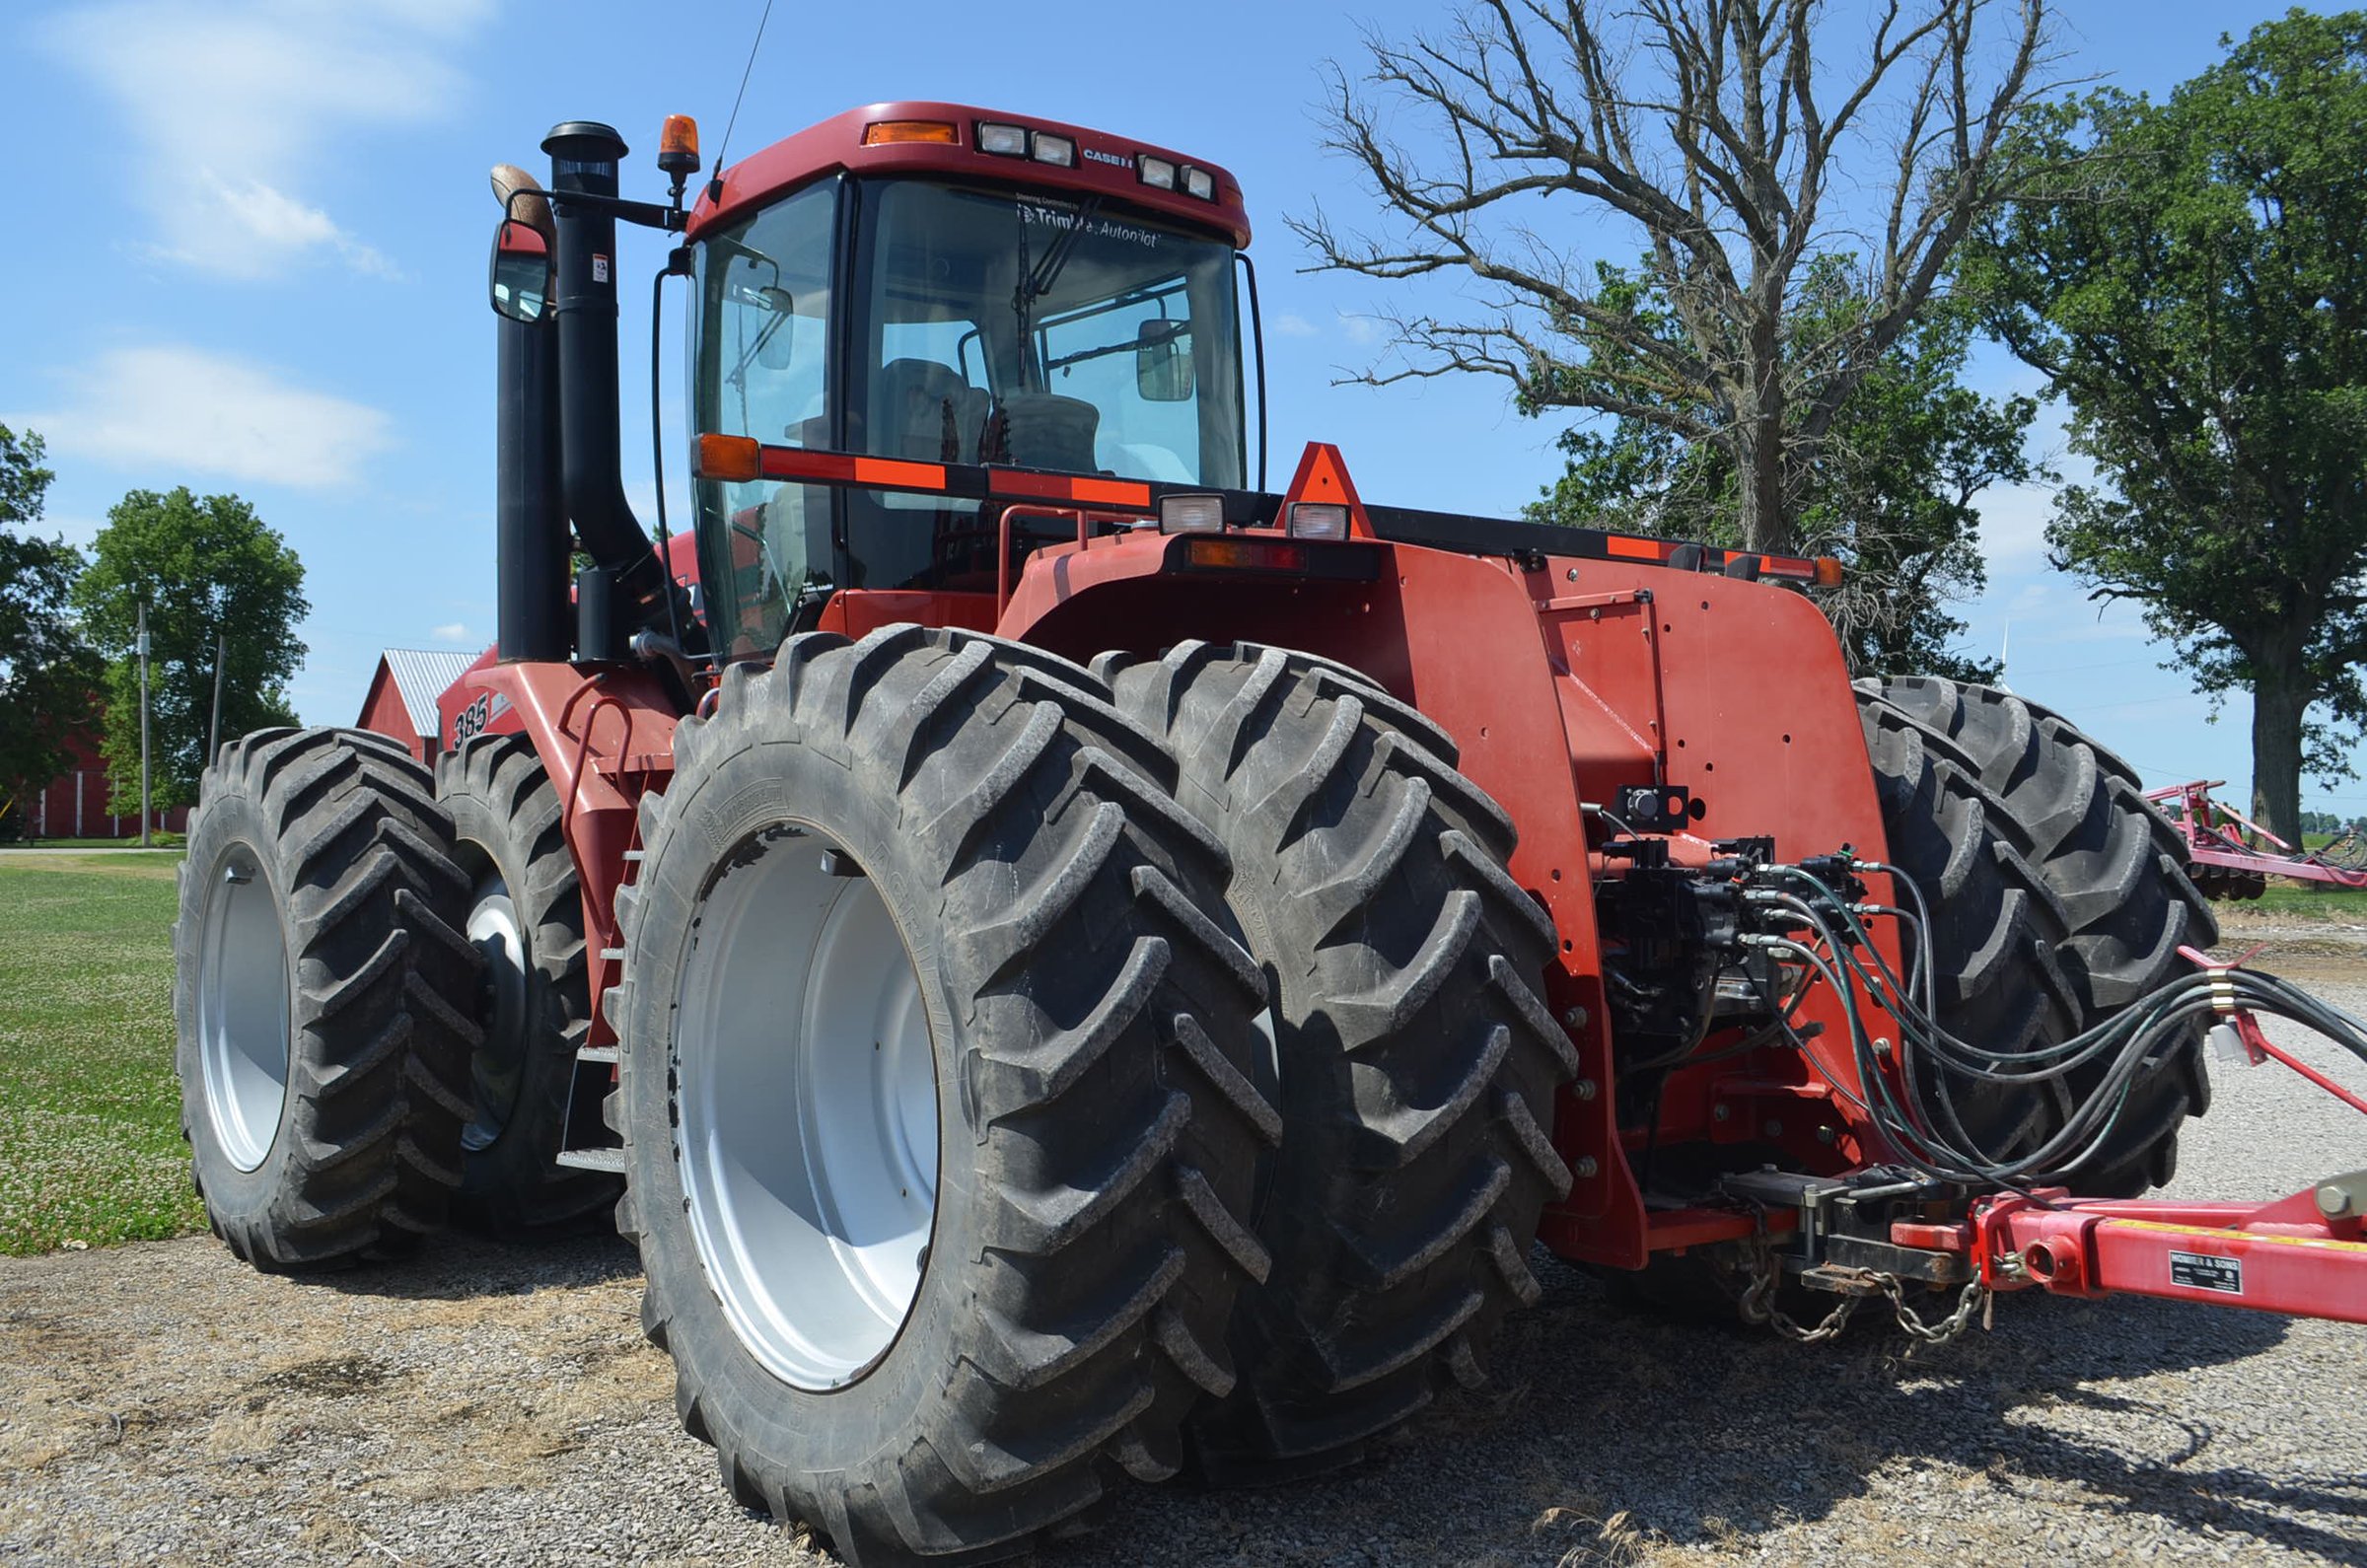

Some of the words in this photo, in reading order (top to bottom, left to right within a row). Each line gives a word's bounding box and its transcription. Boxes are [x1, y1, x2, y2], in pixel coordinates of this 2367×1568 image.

[1083, 148, 1120, 166] CASE
[454, 691, 488, 751] 385
[2214, 1259, 2239, 1270] SONS
